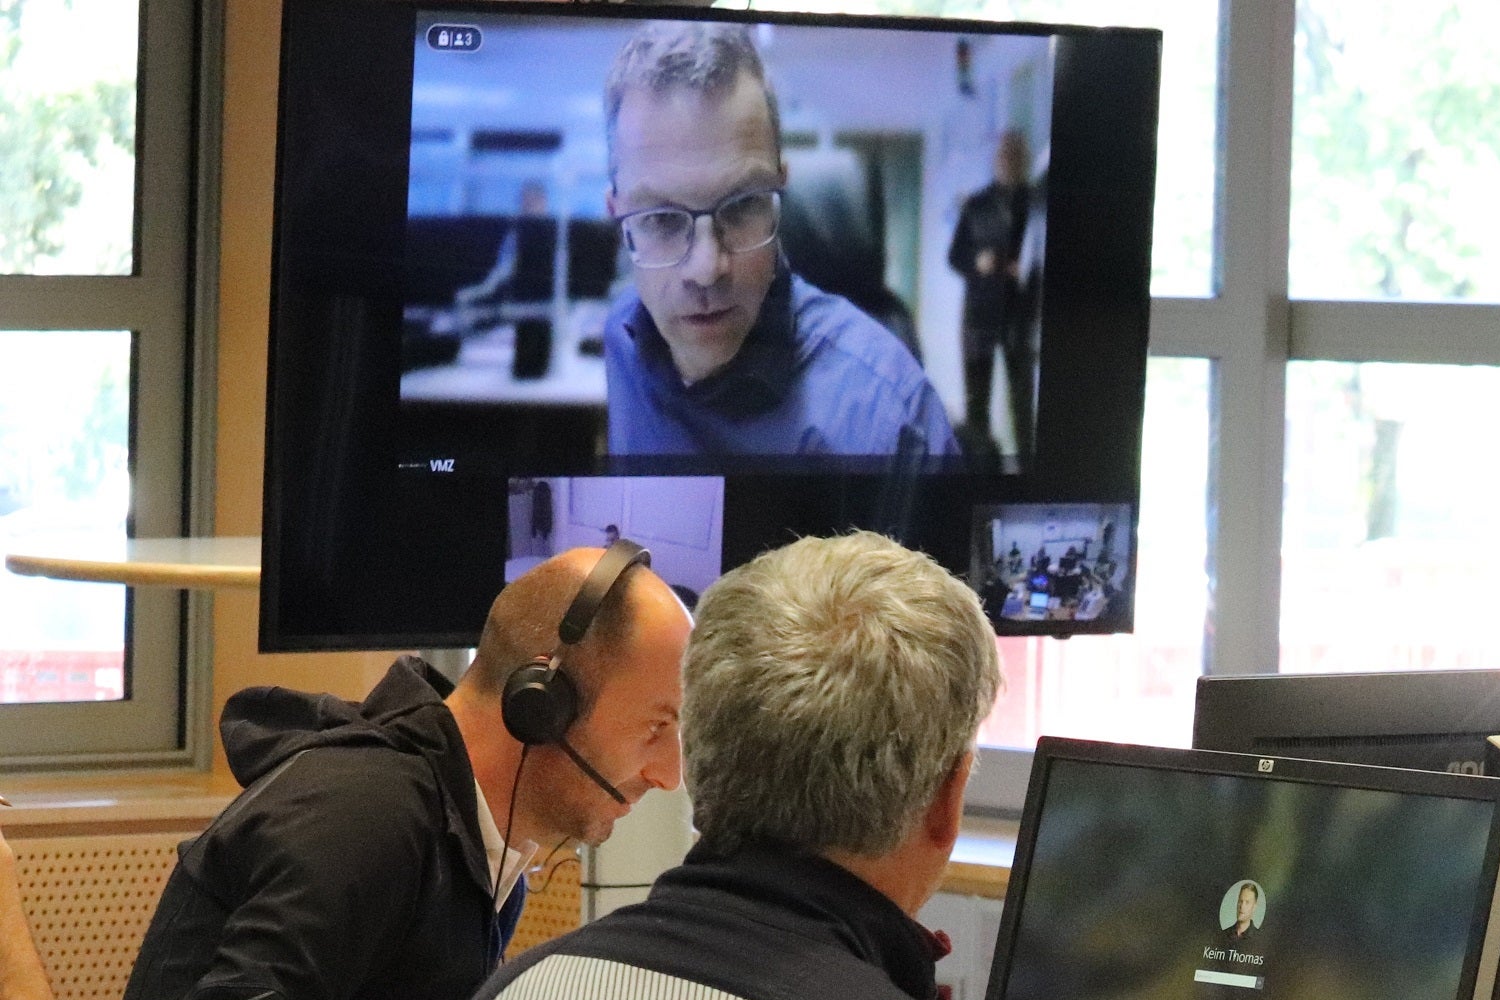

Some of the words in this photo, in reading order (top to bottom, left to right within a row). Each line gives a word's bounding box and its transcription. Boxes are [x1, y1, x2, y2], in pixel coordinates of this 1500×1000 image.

[465, 32, 473, 46] 3
[429, 458, 455, 473] VMZ
[1202, 945, 1226, 961] Keim
[1228, 948, 1265, 966] Thomas
